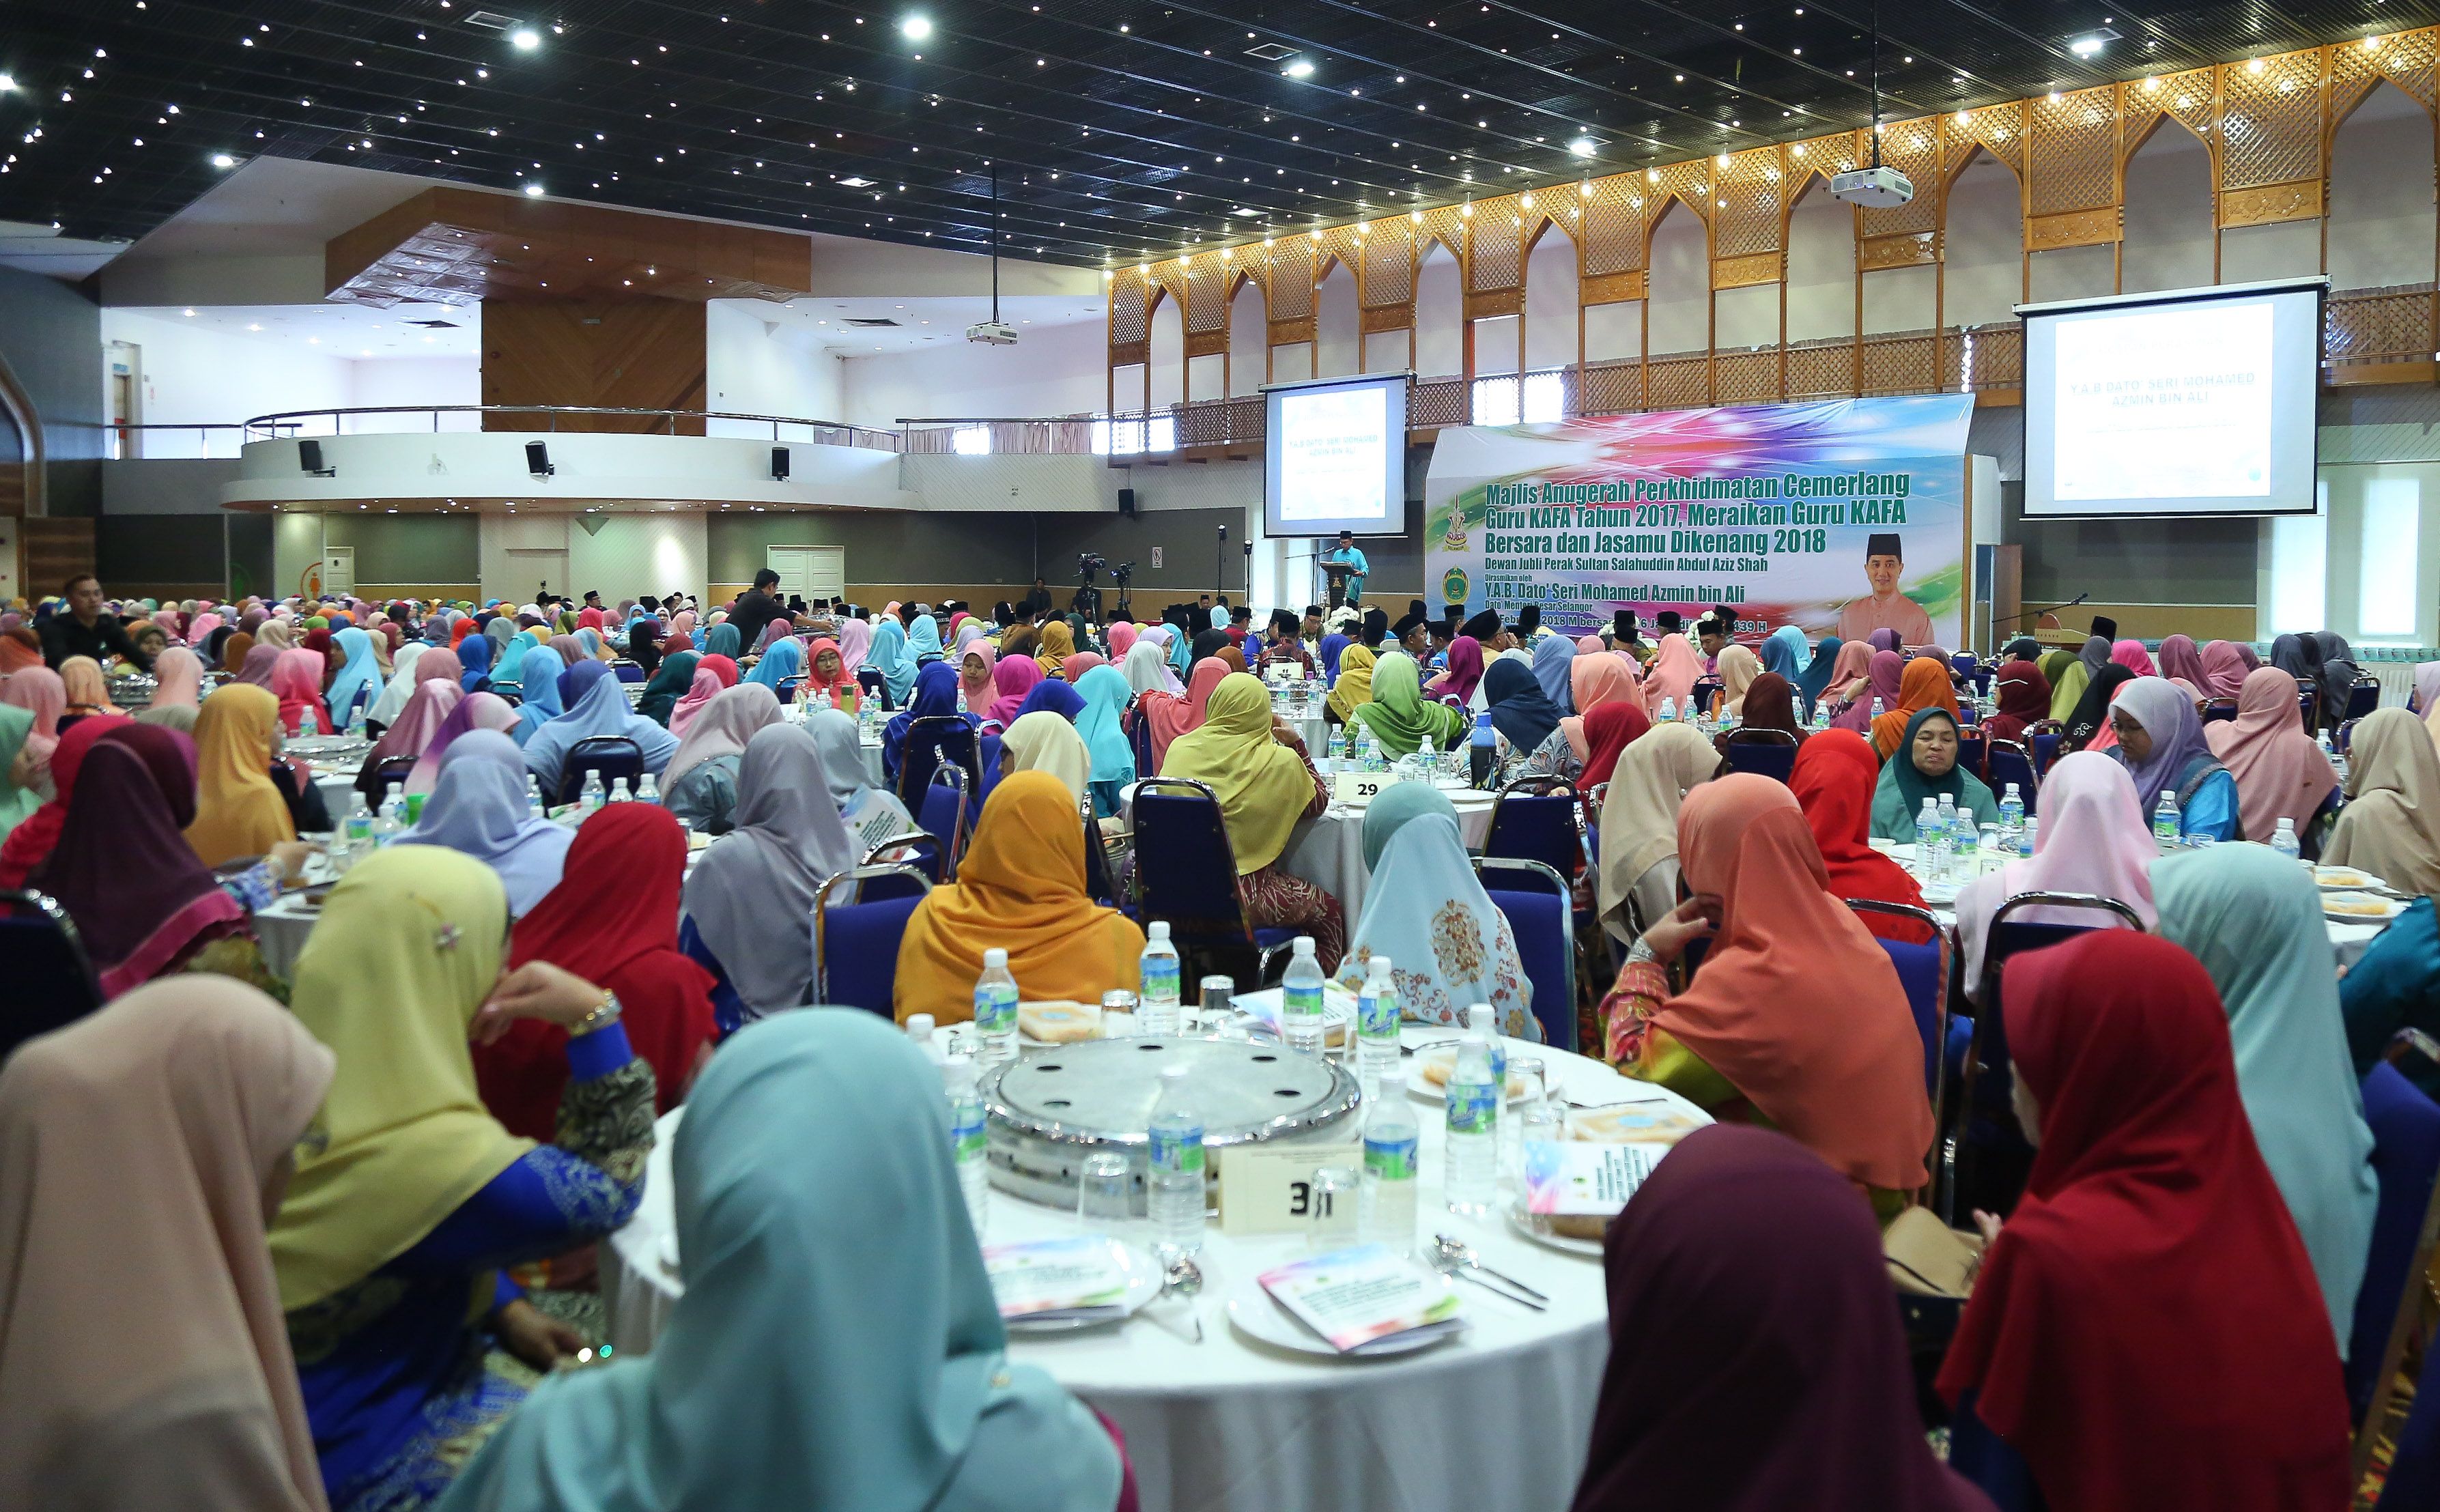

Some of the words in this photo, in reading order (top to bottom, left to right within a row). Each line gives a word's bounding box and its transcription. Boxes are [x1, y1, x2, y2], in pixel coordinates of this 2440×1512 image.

[2148, 377, 2178, 390] SERI
[2184, 372, 2256, 387] MOHAMED
[2112, 395, 2154, 408] AZMIN
[2159, 393, 2182, 405] BIN
[2187, 391, 2209, 403] ALI
[1486, 483, 1538, 506] Majlis
[1542, 481, 1630, 505] Anugerah
[1635, 476, 1778, 502] Perkhidmatan
[1783, 471, 1910, 498] Cemerlang
[1485, 508, 1525, 529] Guru
[1529, 506, 1571, 528] KAFA
[1576, 505, 1631, 528] Tahun
[1635, 504, 1682, 529] 2017,
[1687, 503, 1786, 526] Meraikan
[1791, 500, 1844, 525] Guru
[1850, 499, 1907, 524] KAFA
[1485, 532, 1552, 554] Bersara
[1557, 532, 1590, 554] dan
[1594, 531, 1666, 554] Jasamu
[1671, 530, 1768, 556] Dikenang
[1774, 528, 1826, 554] 2018
[1485, 558, 1516, 570] Dewan
[1519, 558, 1542, 570] Jubli
[1545, 558, 1573, 570] Perak
[1576, 558, 1608, 571] Sultan
[1611, 558, 1674, 571] Salahuddin
[1677, 558, 1710, 571] Abdul
[1712, 558, 1735, 571] Aziz
[1737, 558, 1768, 571] Shah
[1519, 574, 1532, 582] oleh
[1485, 582, 1515, 598] Y.A.B.
[1518, 583, 1549, 599] Dato'
[1552, 583, 1578, 600] Seri
[1581, 584, 1648, 601] Mohamed
[1651, 585, 1694, 601] Azmin
[1698, 585, 1721, 603] bin
[1725, 586, 1745, 603] Ali
[1485, 600, 1503, 610] Dato'
[1558, 601, 1593, 612] Selangor
[1541, 616, 1565, 625] 2018
[1568, 616, 1577, 625] M
[1758, 621, 1767, 632] H
[1358, 784, 1378, 796] 29
